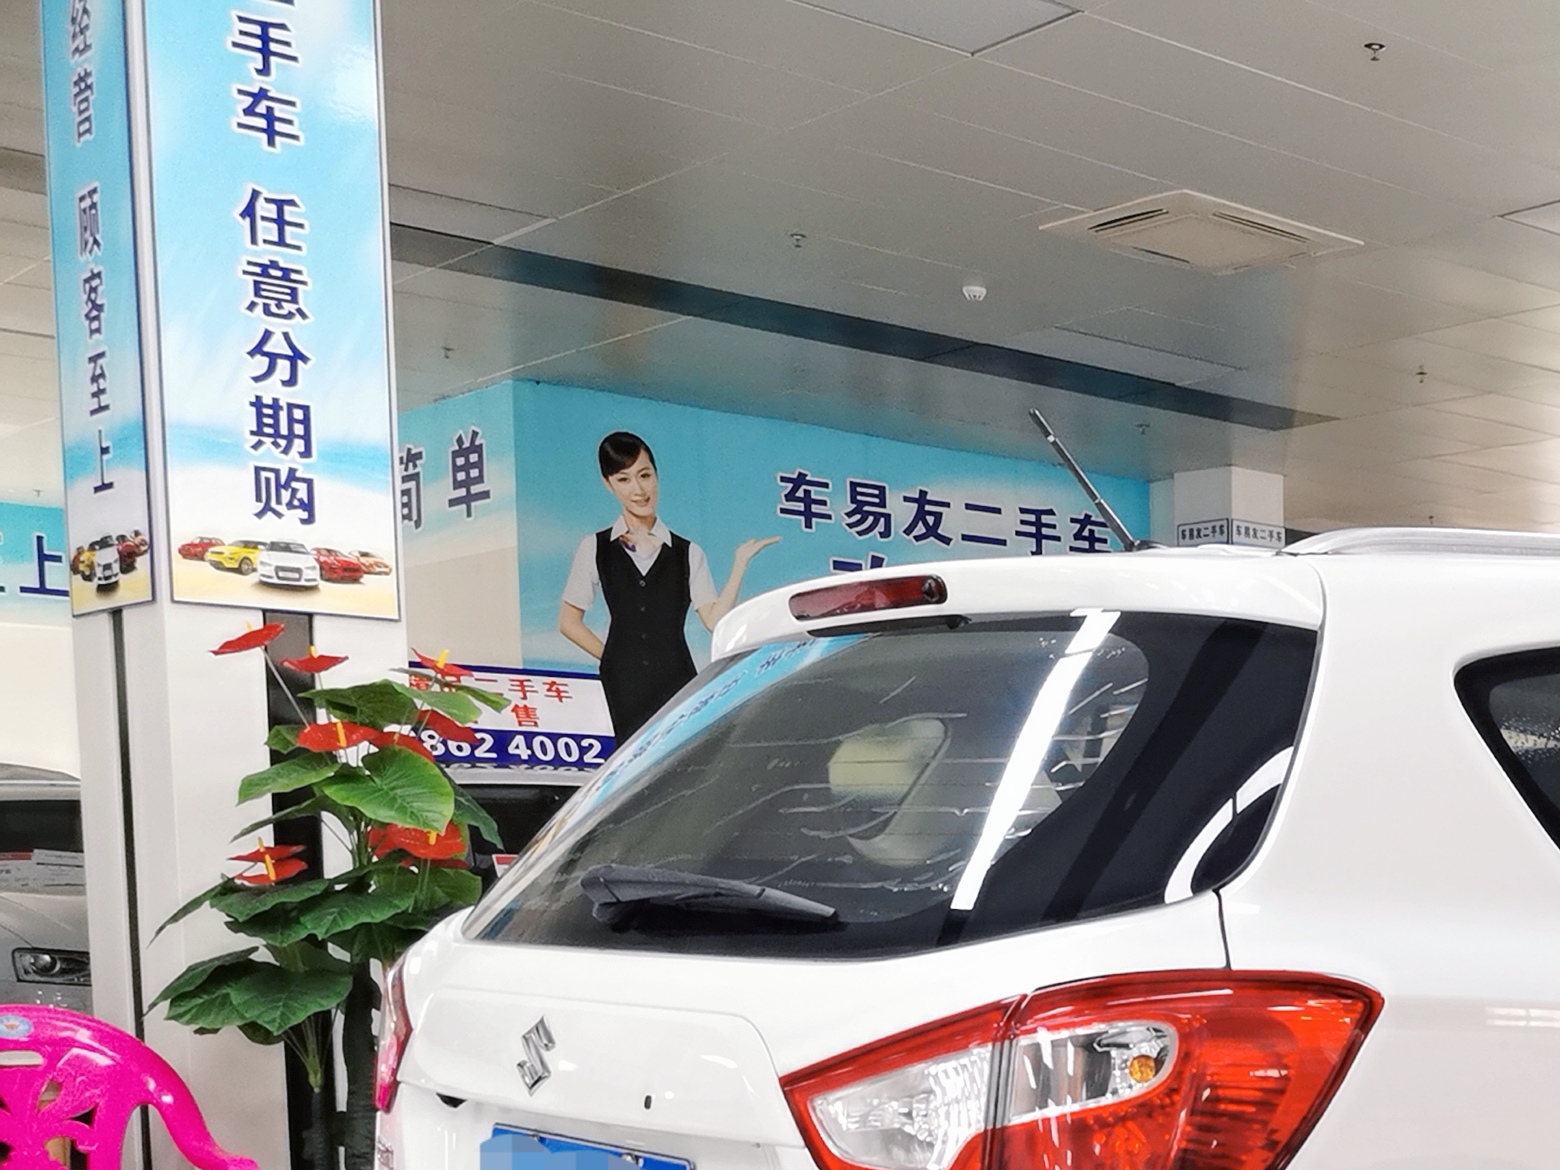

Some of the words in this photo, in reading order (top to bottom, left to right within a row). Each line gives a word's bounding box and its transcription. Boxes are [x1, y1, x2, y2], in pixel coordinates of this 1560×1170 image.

[78, 186, 115, 495] 顾客至上
[239, 187, 317, 526] 任意分期购
[778, 470, 1112, 556] 车易友二手车
[507, 733, 606, 764] 4002
